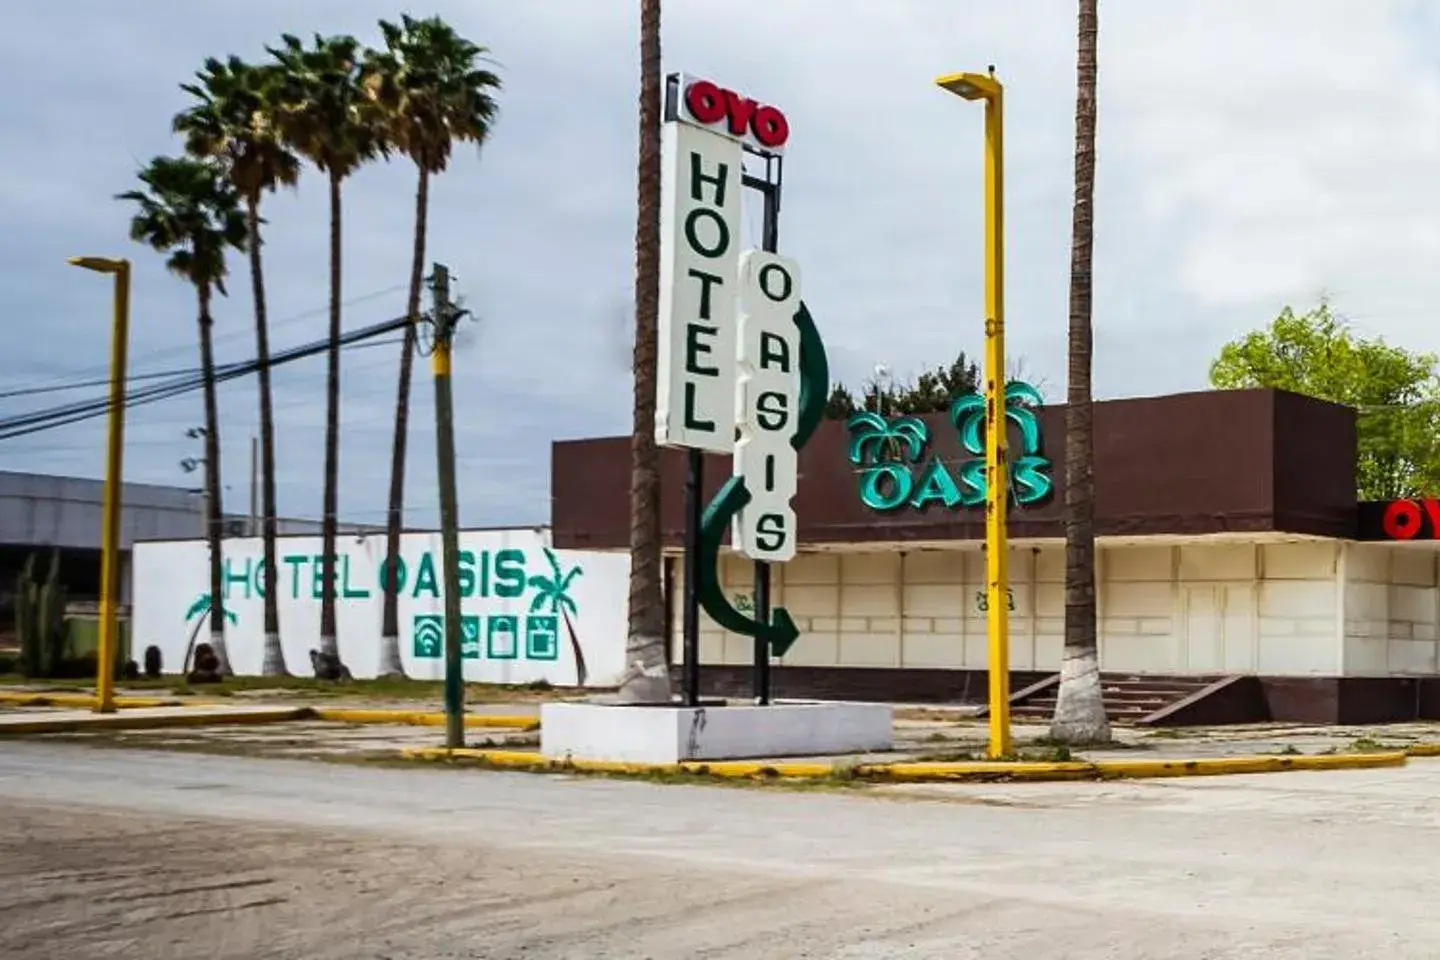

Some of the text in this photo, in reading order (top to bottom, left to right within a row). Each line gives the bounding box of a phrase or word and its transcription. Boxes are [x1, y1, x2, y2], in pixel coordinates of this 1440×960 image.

[684, 81, 789, 147] OYO
[684, 151, 731, 432] HOTEL
[755, 262, 792, 553] OASIS
[860, 456, 1053, 509] OASS
